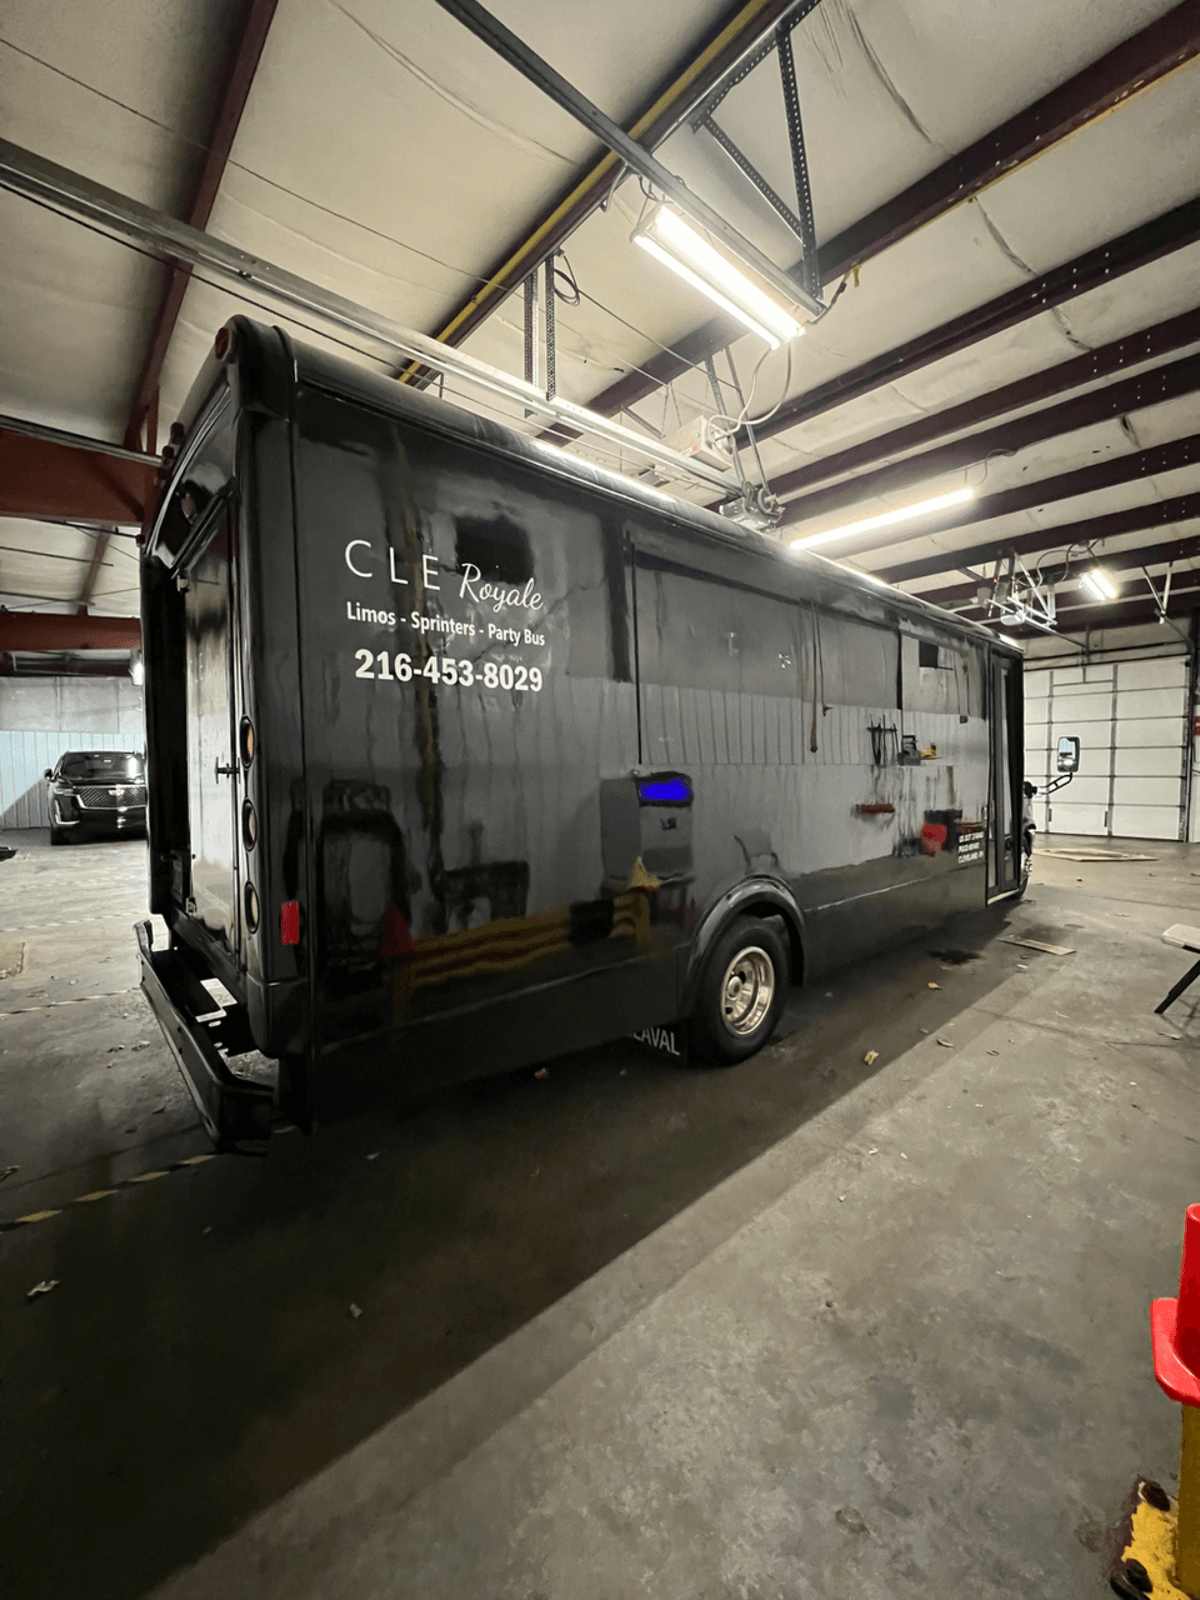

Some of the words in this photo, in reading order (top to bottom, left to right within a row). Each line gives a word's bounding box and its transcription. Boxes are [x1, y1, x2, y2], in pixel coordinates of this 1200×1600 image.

[459, 563, 545, 613] Royale
[346, 601, 396, 626] Limos
[411, 611, 476, 636] Sprinters
[488, 623, 521, 647] Party
[524, 629, 546, 646] Bus
[354, 649, 544, 692] 216-453-8029
